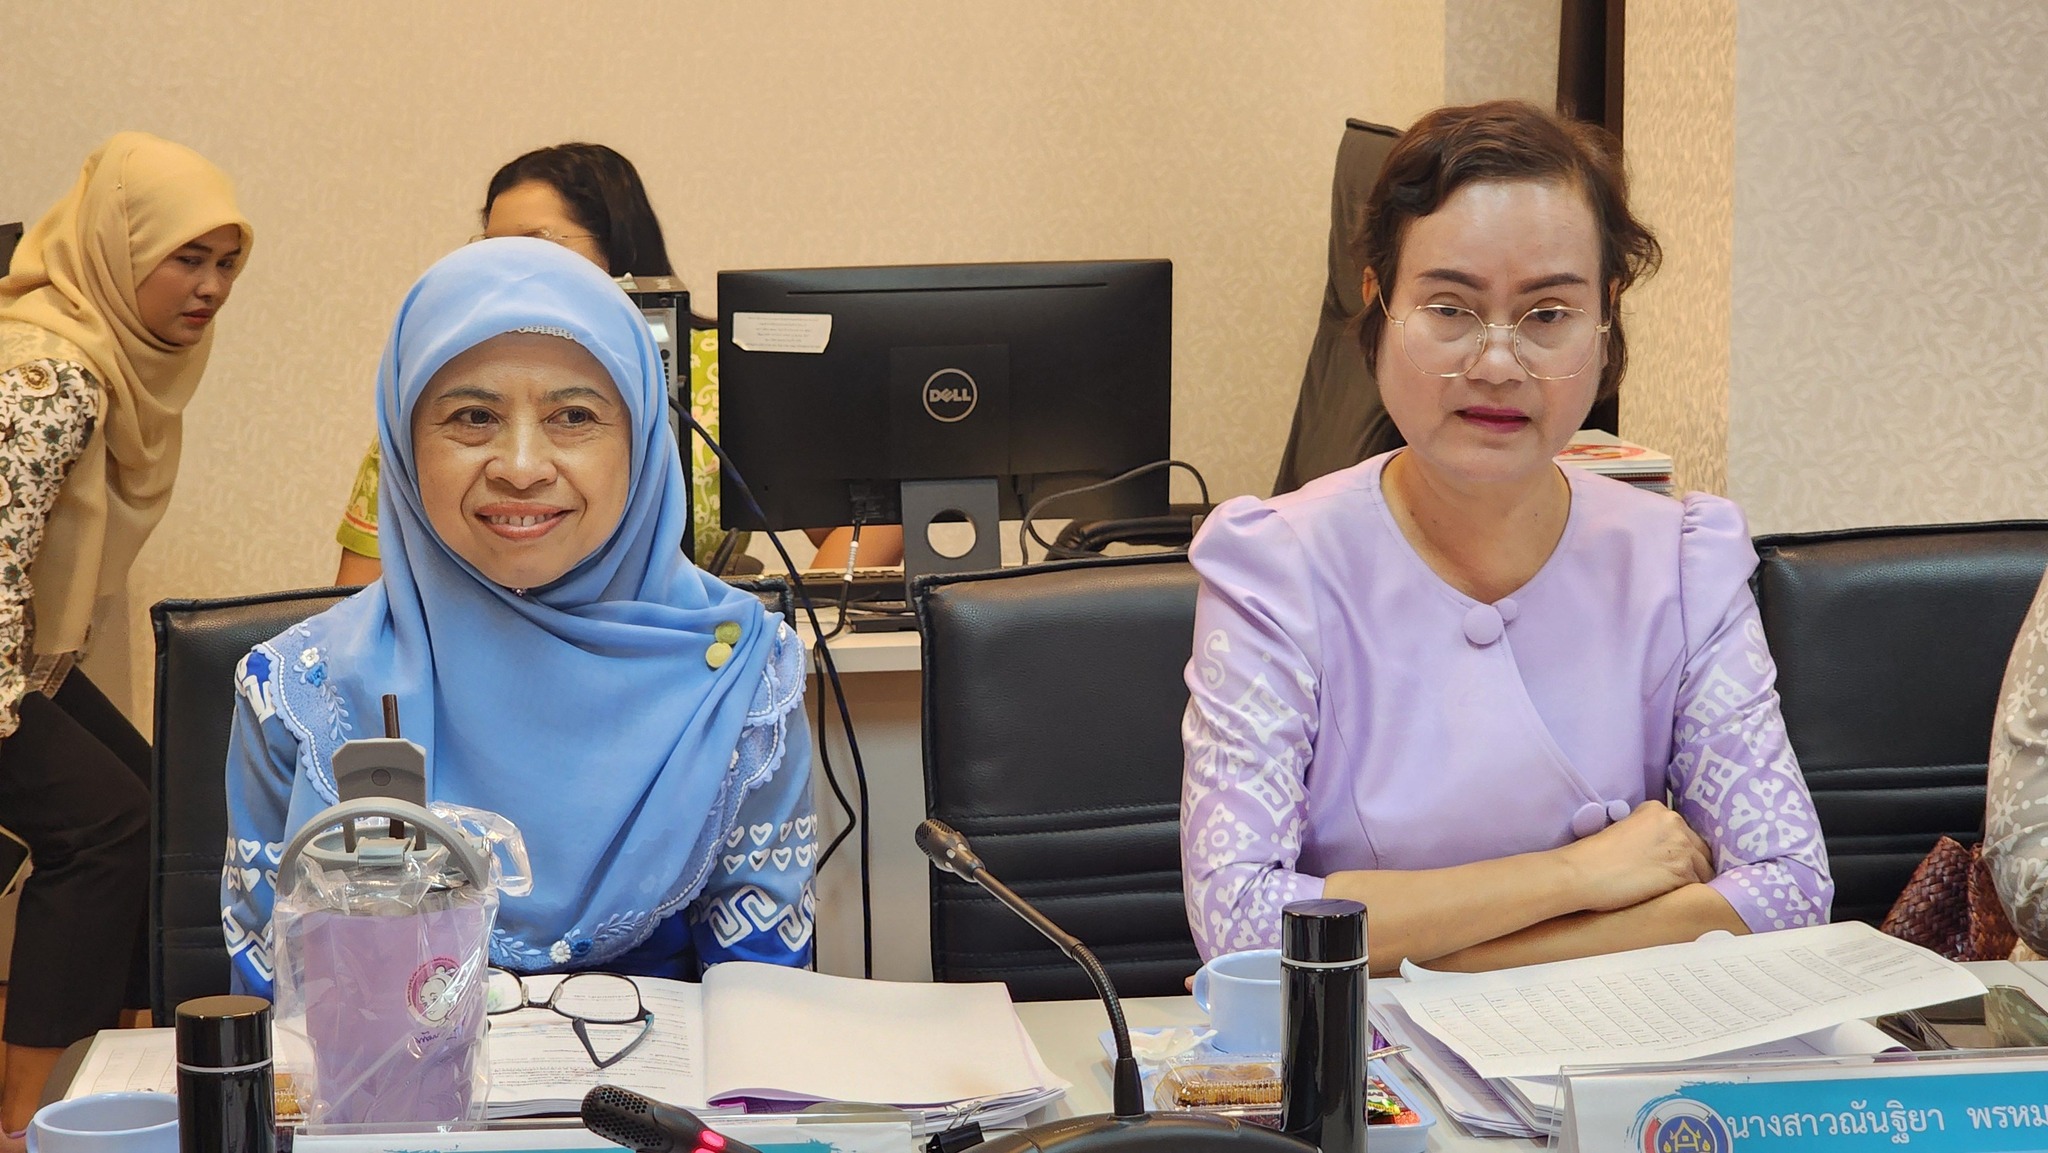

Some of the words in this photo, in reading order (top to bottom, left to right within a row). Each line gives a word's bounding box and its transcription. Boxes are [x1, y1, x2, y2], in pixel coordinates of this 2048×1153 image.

[929, 388, 972, 403] DELL
[1726, 1099, 1945, 1144] นางสาวณันฐิยา
[1966, 1104, 2048, 1129] พรหม
